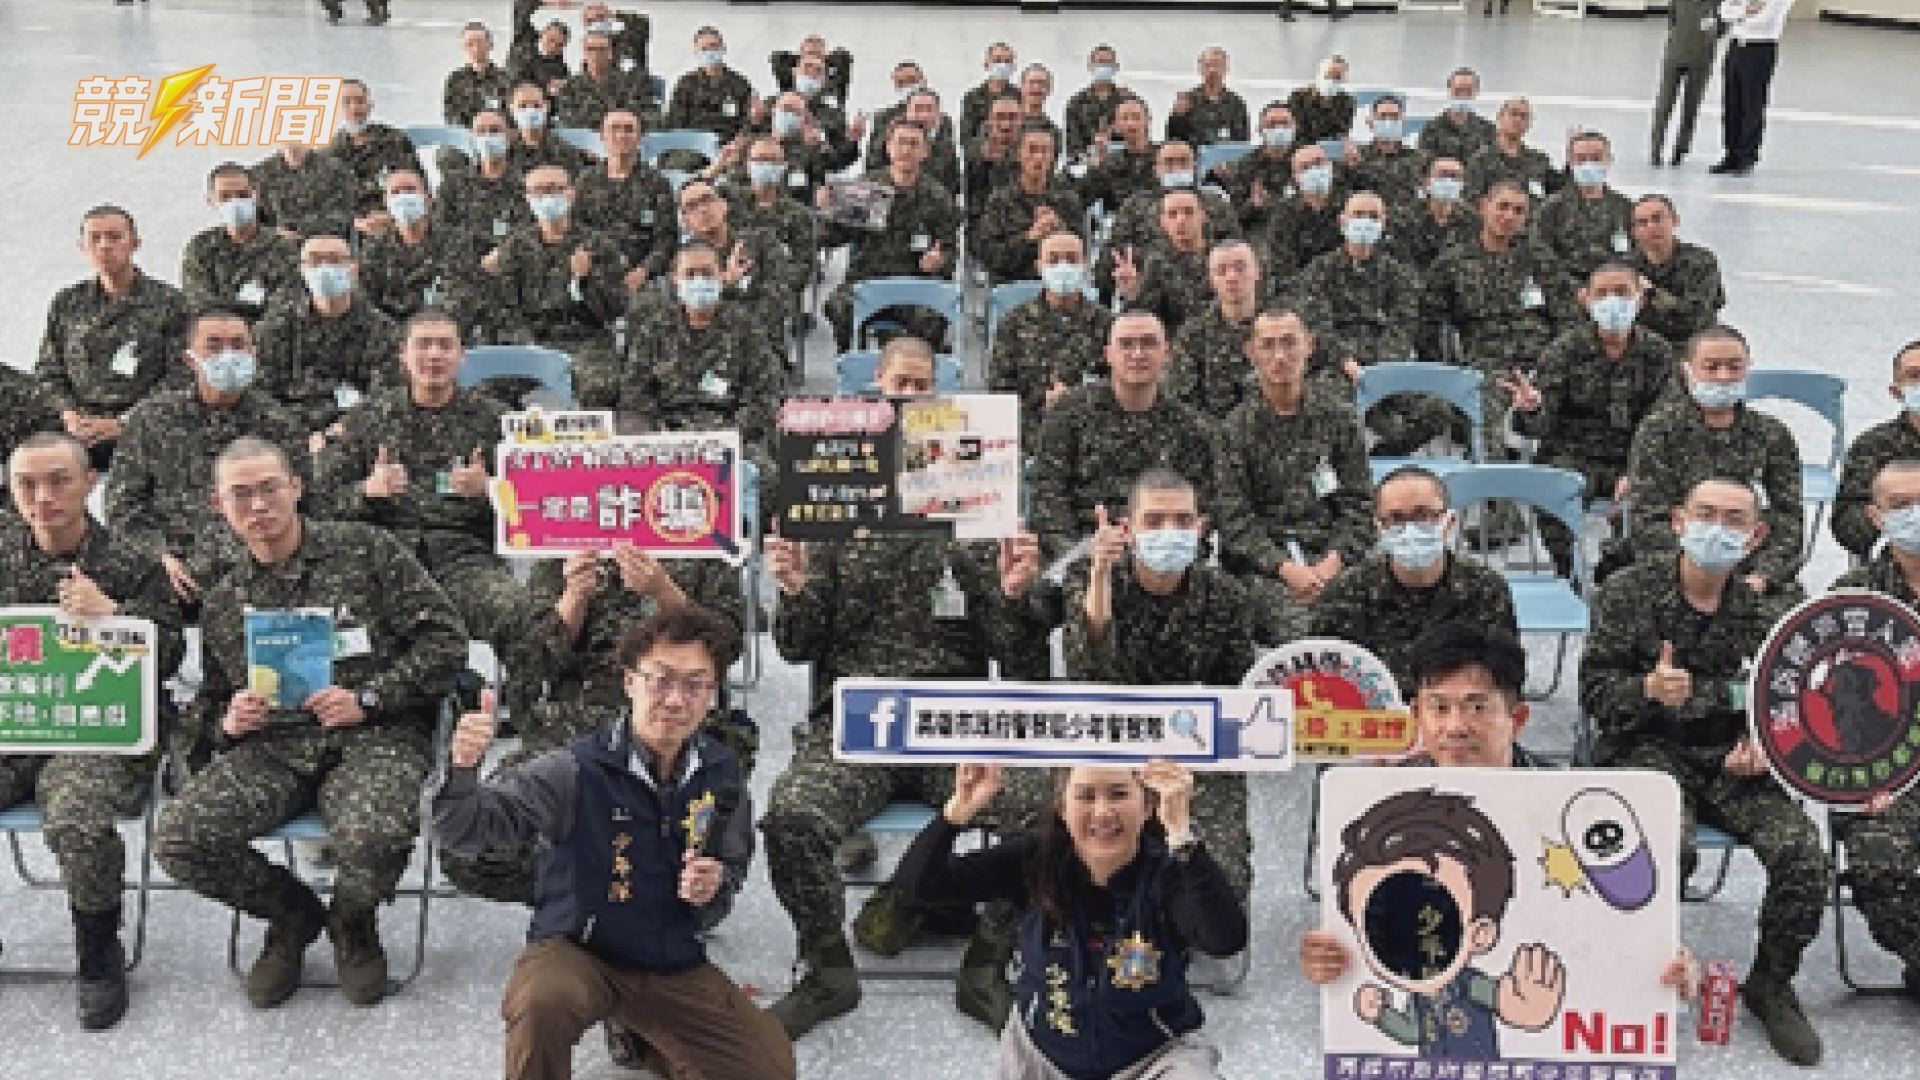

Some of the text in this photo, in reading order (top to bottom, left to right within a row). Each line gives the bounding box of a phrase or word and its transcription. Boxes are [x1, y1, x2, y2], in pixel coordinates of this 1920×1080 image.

[516, 483, 707, 531] 一定是詐騙
[1563, 1010, 1669, 1055] No!
